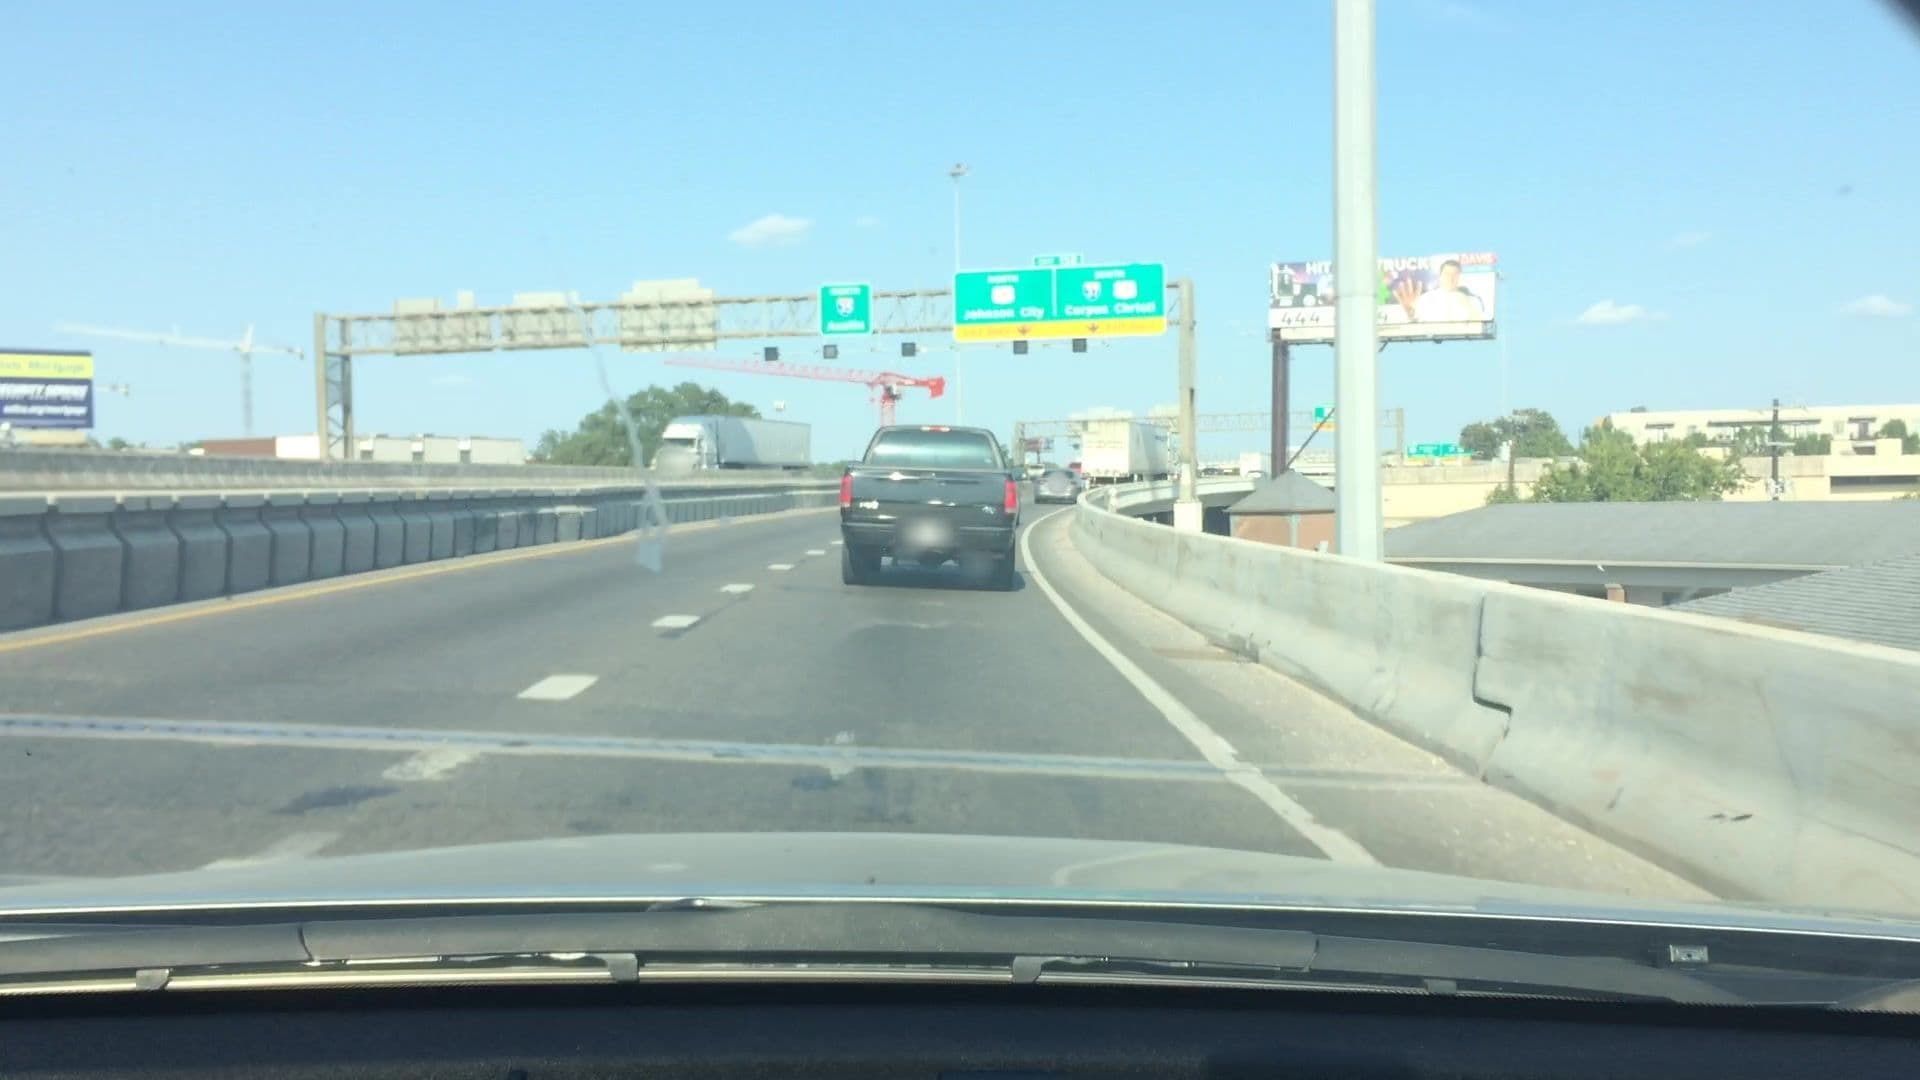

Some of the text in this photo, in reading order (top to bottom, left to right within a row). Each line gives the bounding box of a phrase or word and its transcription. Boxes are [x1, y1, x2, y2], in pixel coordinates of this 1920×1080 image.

[963, 305, 1046, 321] Johnson City
[1064, 300, 1157, 318] Corpus Christi
